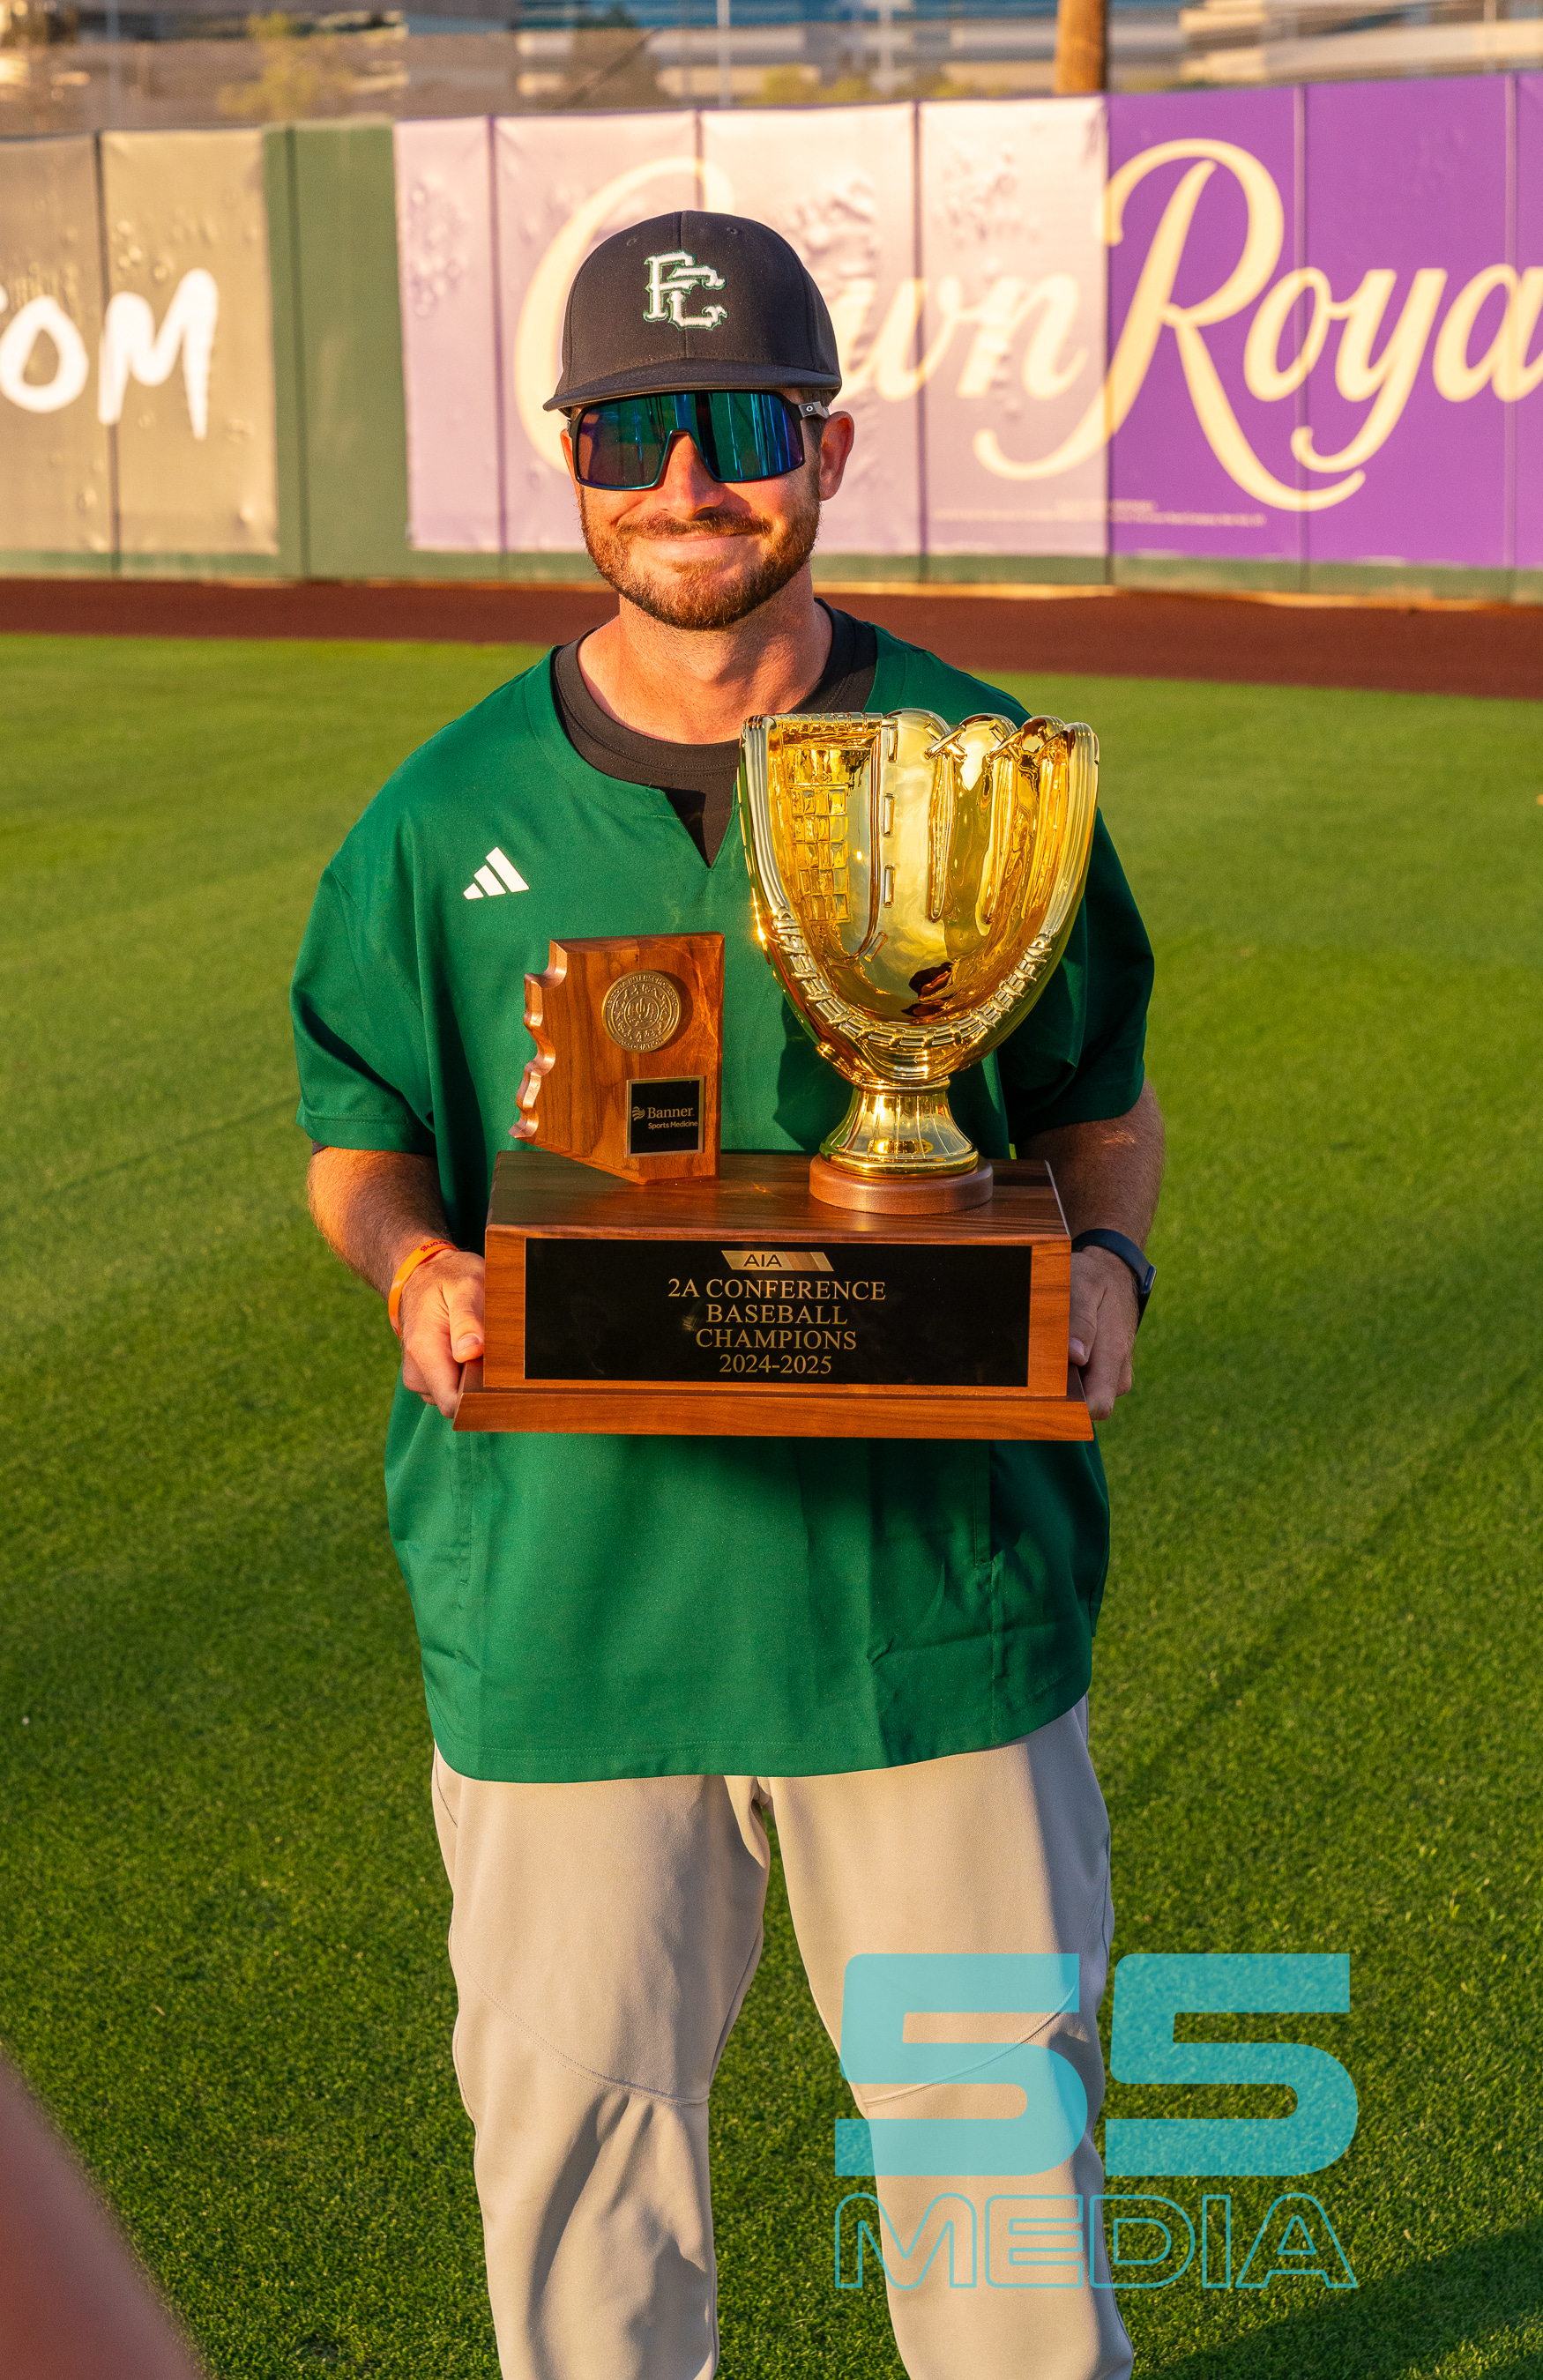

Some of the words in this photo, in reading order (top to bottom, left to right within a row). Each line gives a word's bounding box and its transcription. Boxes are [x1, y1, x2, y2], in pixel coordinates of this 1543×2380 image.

[643, 249, 728, 331] FC
[0, 267, 220, 442] OM
[646, 1106, 694, 1119] Banner
[648, 1122, 670, 1131] Sports
[742, 1253, 783, 1268] AIA
[667, 1278, 701, 1298] 2A
[705, 1279, 887, 1300] CONFERENCE
[705, 1304, 848, 1325] BASEBALL
[696, 1328, 857, 1350] CHAMPIONS
[719, 1354, 832, 1374] 2024-2025
